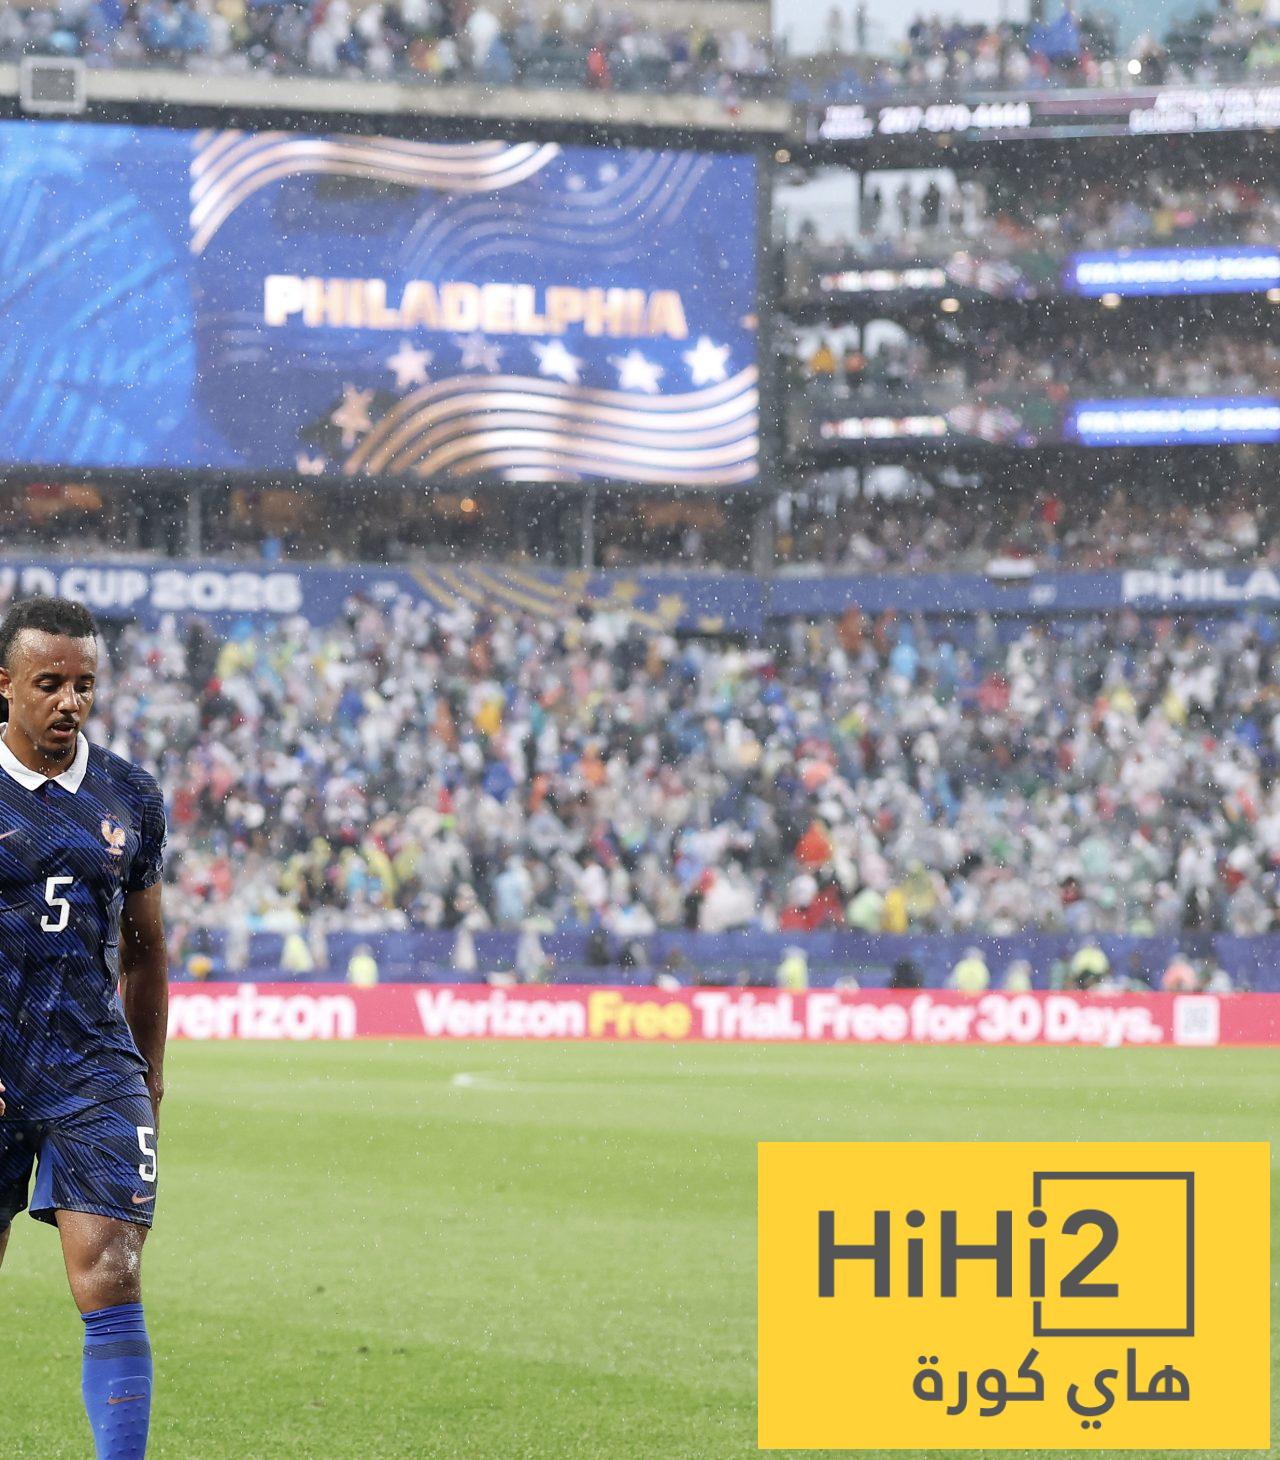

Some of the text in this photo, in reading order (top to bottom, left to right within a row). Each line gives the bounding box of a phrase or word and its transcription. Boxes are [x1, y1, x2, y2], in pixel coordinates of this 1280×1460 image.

[264, 275, 688, 340] PHILADELPHIA
[60, 568, 148, 607] CUP
[151, 572, 302, 612] 2026
[41, 876, 73, 932] 5
[416, 990, 1163, 1046] Verizon Free Trial. Free for 30 Days.
[137, 1126, 157, 1182] 5
